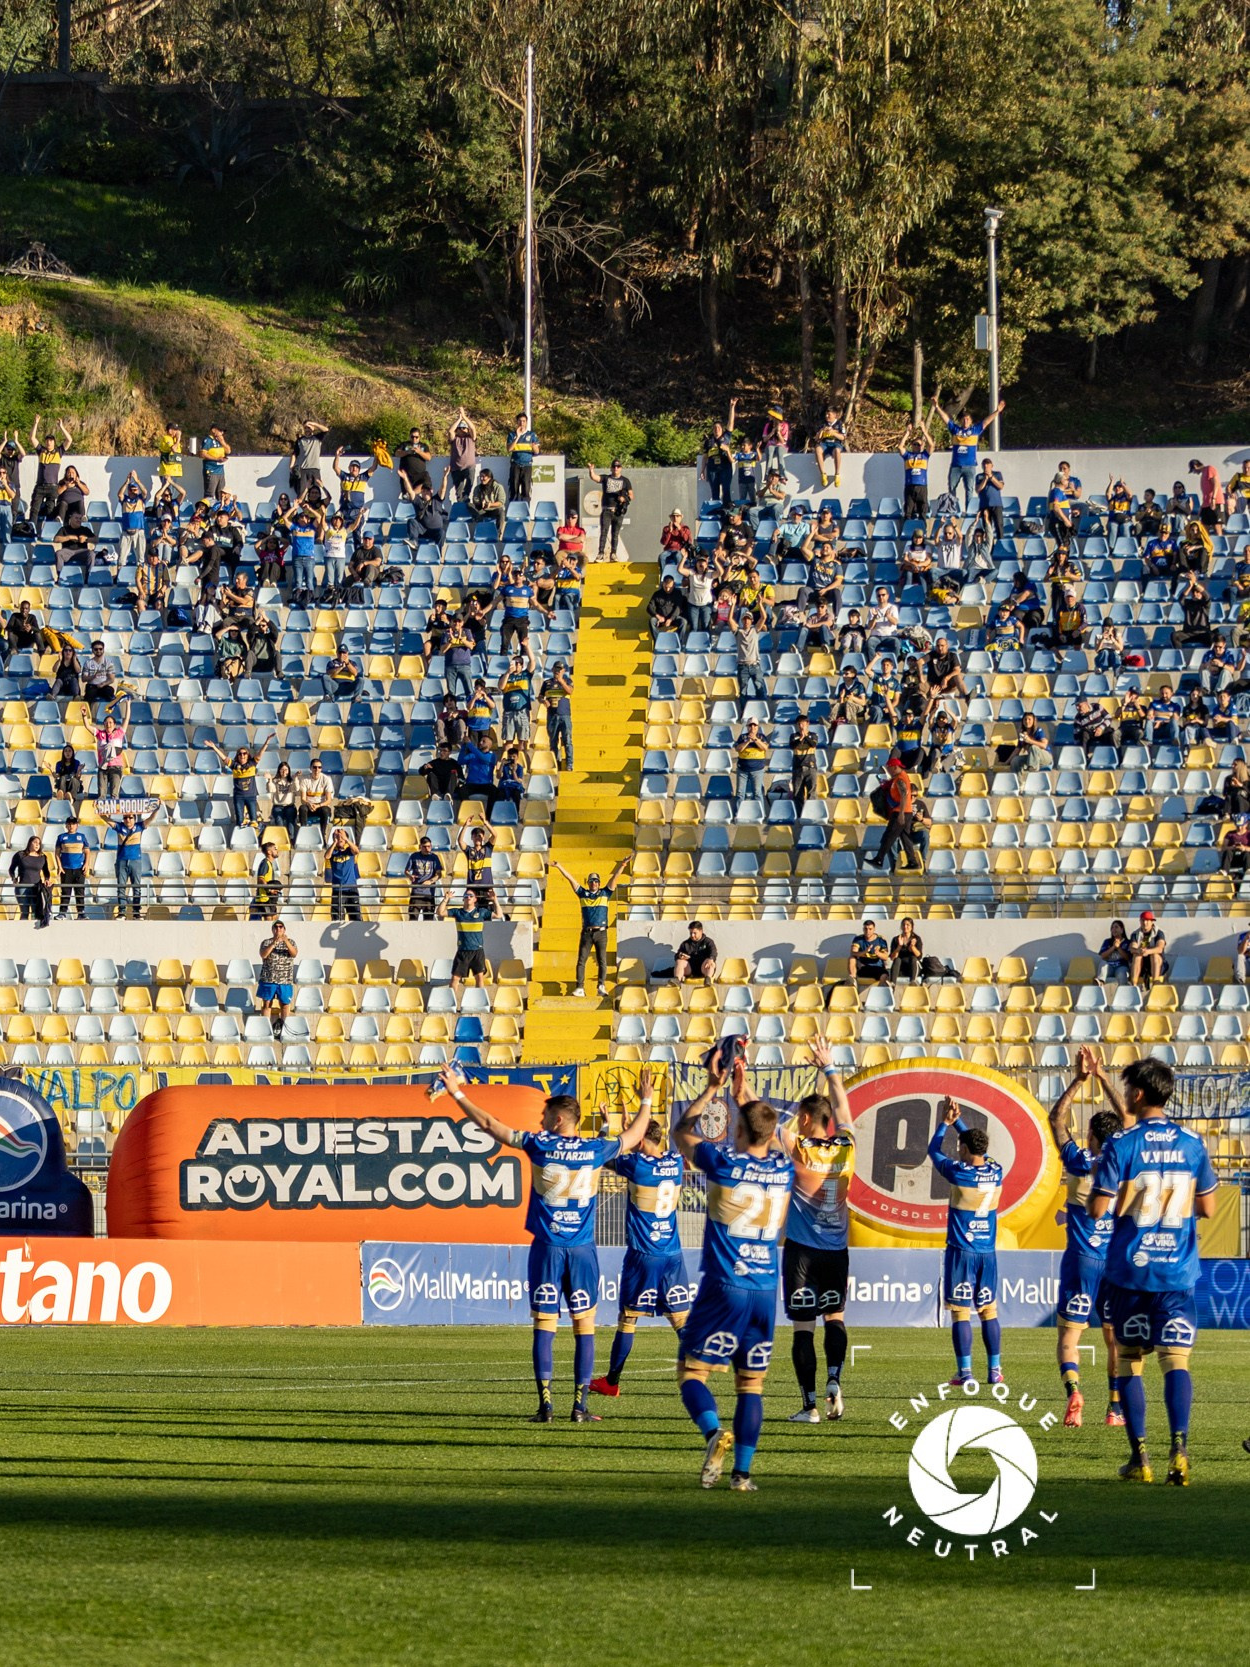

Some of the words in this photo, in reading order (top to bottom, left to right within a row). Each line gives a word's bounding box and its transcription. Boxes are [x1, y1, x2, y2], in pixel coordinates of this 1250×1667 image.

[98, 800, 117, 814] SAN
[119, 799, 150, 813] ROQUE
[25, 1067, 140, 1111] VALPO
[203, 1121, 496, 1156] APUESTAS
[1145, 1130, 1176, 1142] Claro
[186, 1162, 515, 1204] ROYAL.COM
[541, 1163, 594, 1208] 24
[652, 1167, 679, 1176] L.SOTO
[654, 1180, 676, 1218] 8
[727, 1181, 787, 1240] 21
[820, 1179, 839, 1212] 1
[880, 1203, 931, 1220] DESDE
[974, 1182, 997, 1218] 7
[1132, 1171, 1192, 1228] 37
